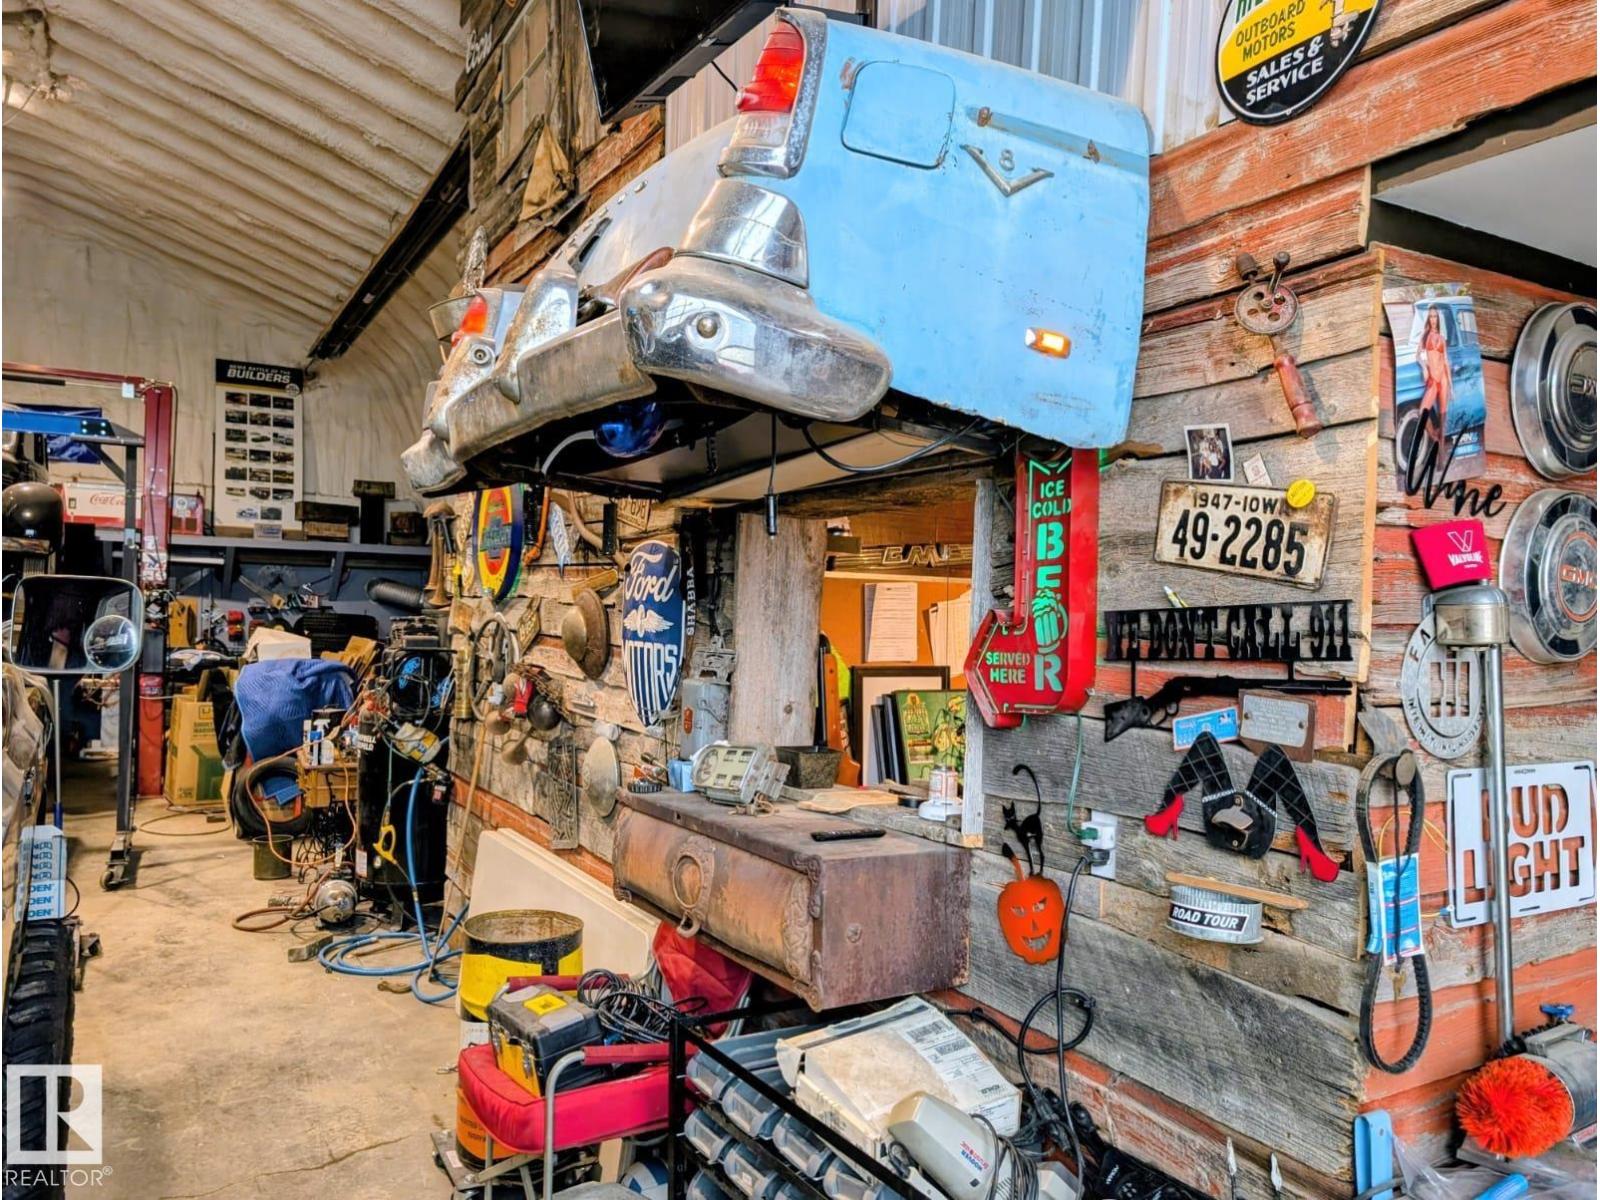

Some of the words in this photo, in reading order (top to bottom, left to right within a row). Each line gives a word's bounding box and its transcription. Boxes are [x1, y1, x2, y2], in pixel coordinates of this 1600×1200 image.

[1236, 0, 1306, 47] OUTBOARD
[1243, 22, 1296, 62] MOTORS
[1245, 56, 1324, 107] SERVICE
[1246, 47, 1304, 88] SALES
[1307, 35, 1323, 58] &
[227, 368, 291, 384] BUILDERS
[1032, 499, 1071, 518] COLD
[1040, 479, 1065, 499] ICE
[1172, 509, 1308, 577] 49-2285
[625, 552, 678, 603] Ford
[985, 652, 1030, 666] SERVED
[990, 667, 1026, 684] HERE
[625, 640, 678, 727] OTORS
[1464, 836, 1584, 904] LIGHT
[1172, 906, 1202, 923] ROAD
[1203, 913, 1239, 929] TOUR
